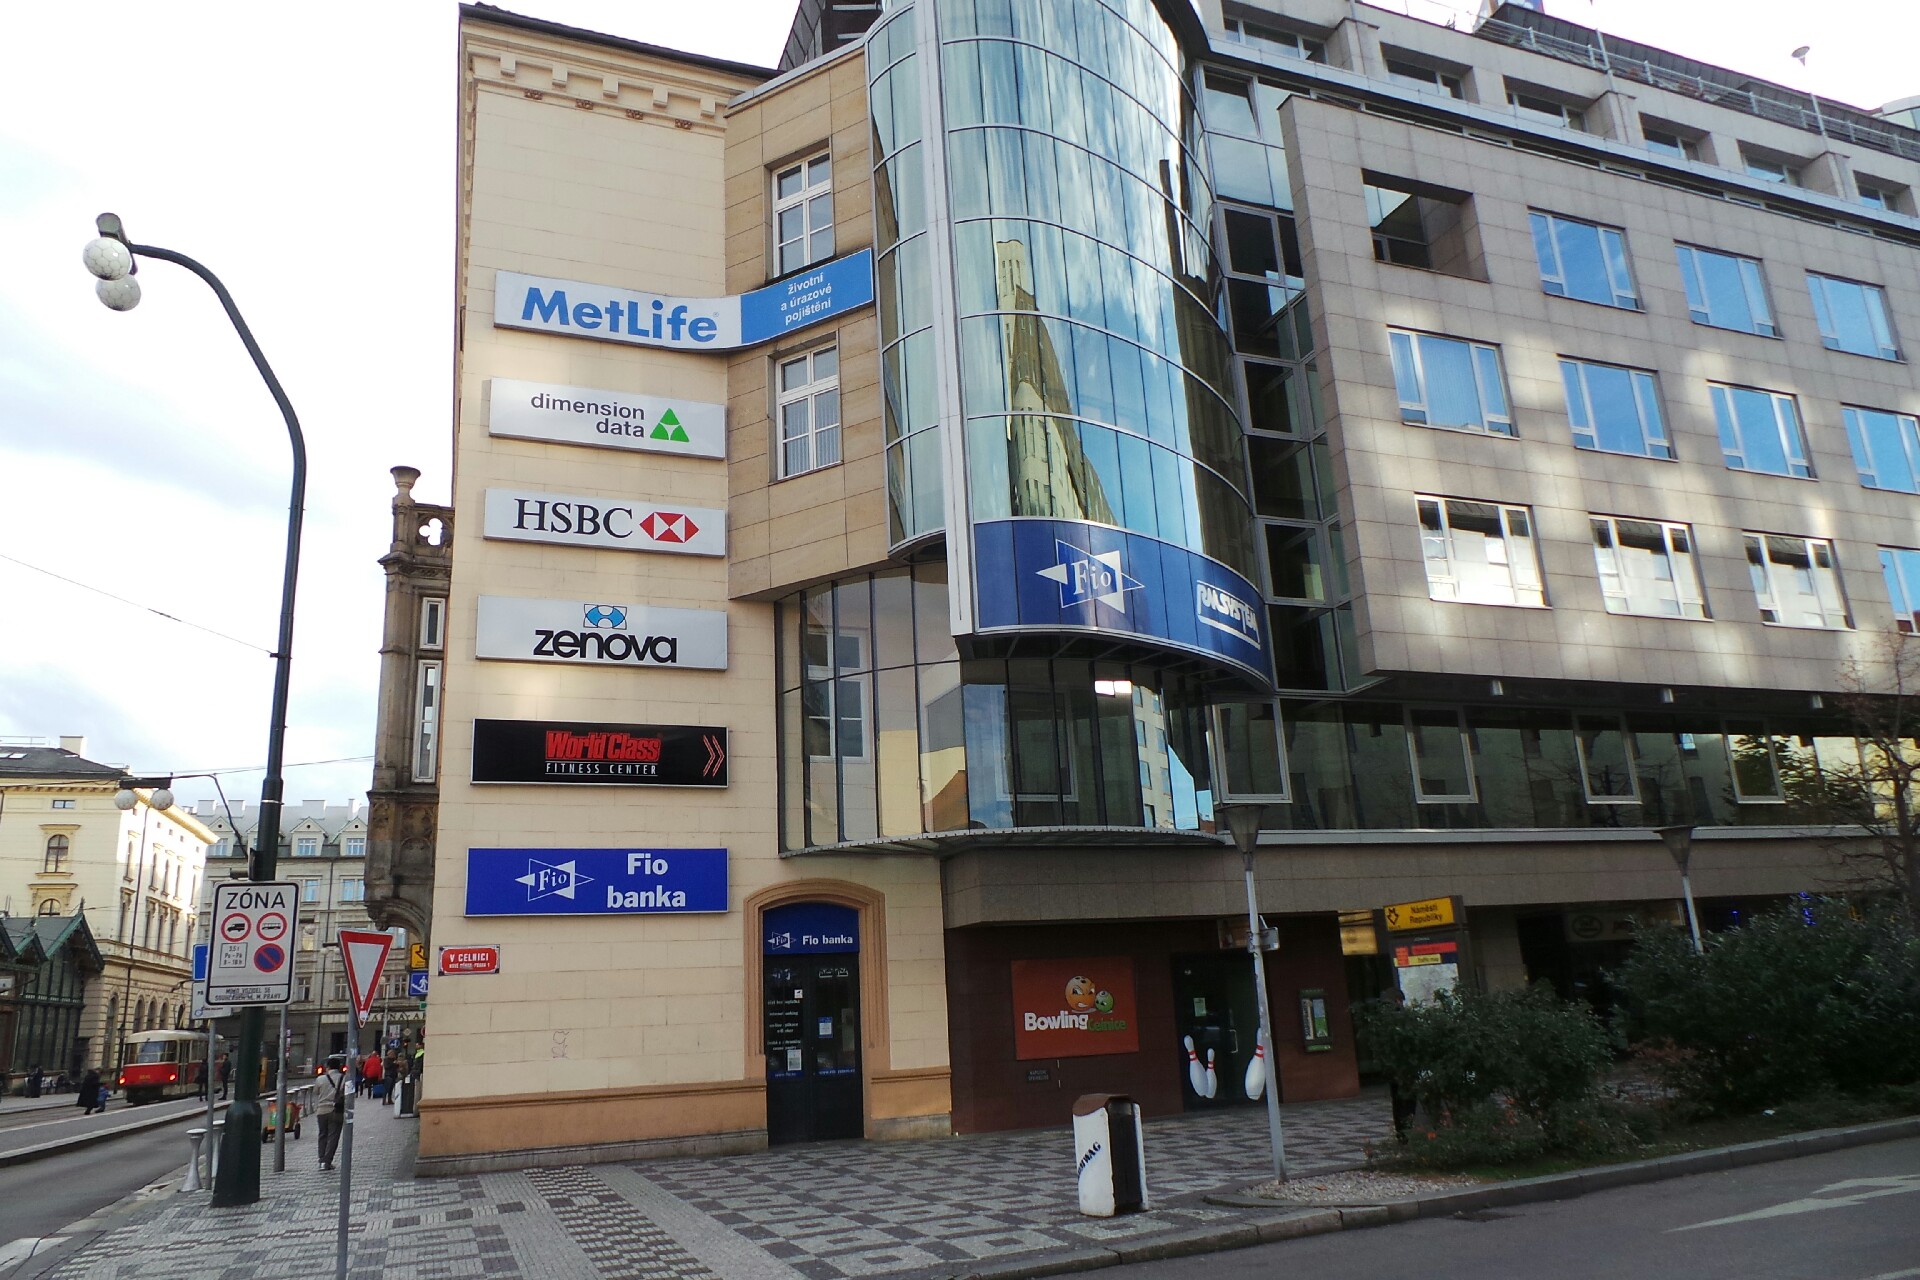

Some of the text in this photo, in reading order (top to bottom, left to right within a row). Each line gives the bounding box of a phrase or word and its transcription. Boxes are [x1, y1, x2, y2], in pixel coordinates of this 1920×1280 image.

[788, 272, 824, 295] životní
[781, 283, 832, 311] a úrazové
[521, 288, 718, 342] MetLife
[785, 298, 831, 325] pojištění
[530, 393, 645, 419] dimension
[596, 418, 645, 439] data
[513, 498, 633, 539] HSBC
[1071, 560, 1111, 595] Fio
[533, 629, 677, 664] zenova
[546, 731, 661, 762] World Class
[546, 763, 656, 775] FITNESS CENTER
[627, 853, 668, 876] Fio
[537, 869, 567, 892] Fio
[226, 888, 286, 909] ZÓNA
[607, 885, 686, 908] banka
[1410, 914, 1442, 923] Republiky
[802, 934, 853, 945] Fio banka
[449, 953, 489, 962] V CELNICI
[1024, 1011, 1089, 1031] Bowling
